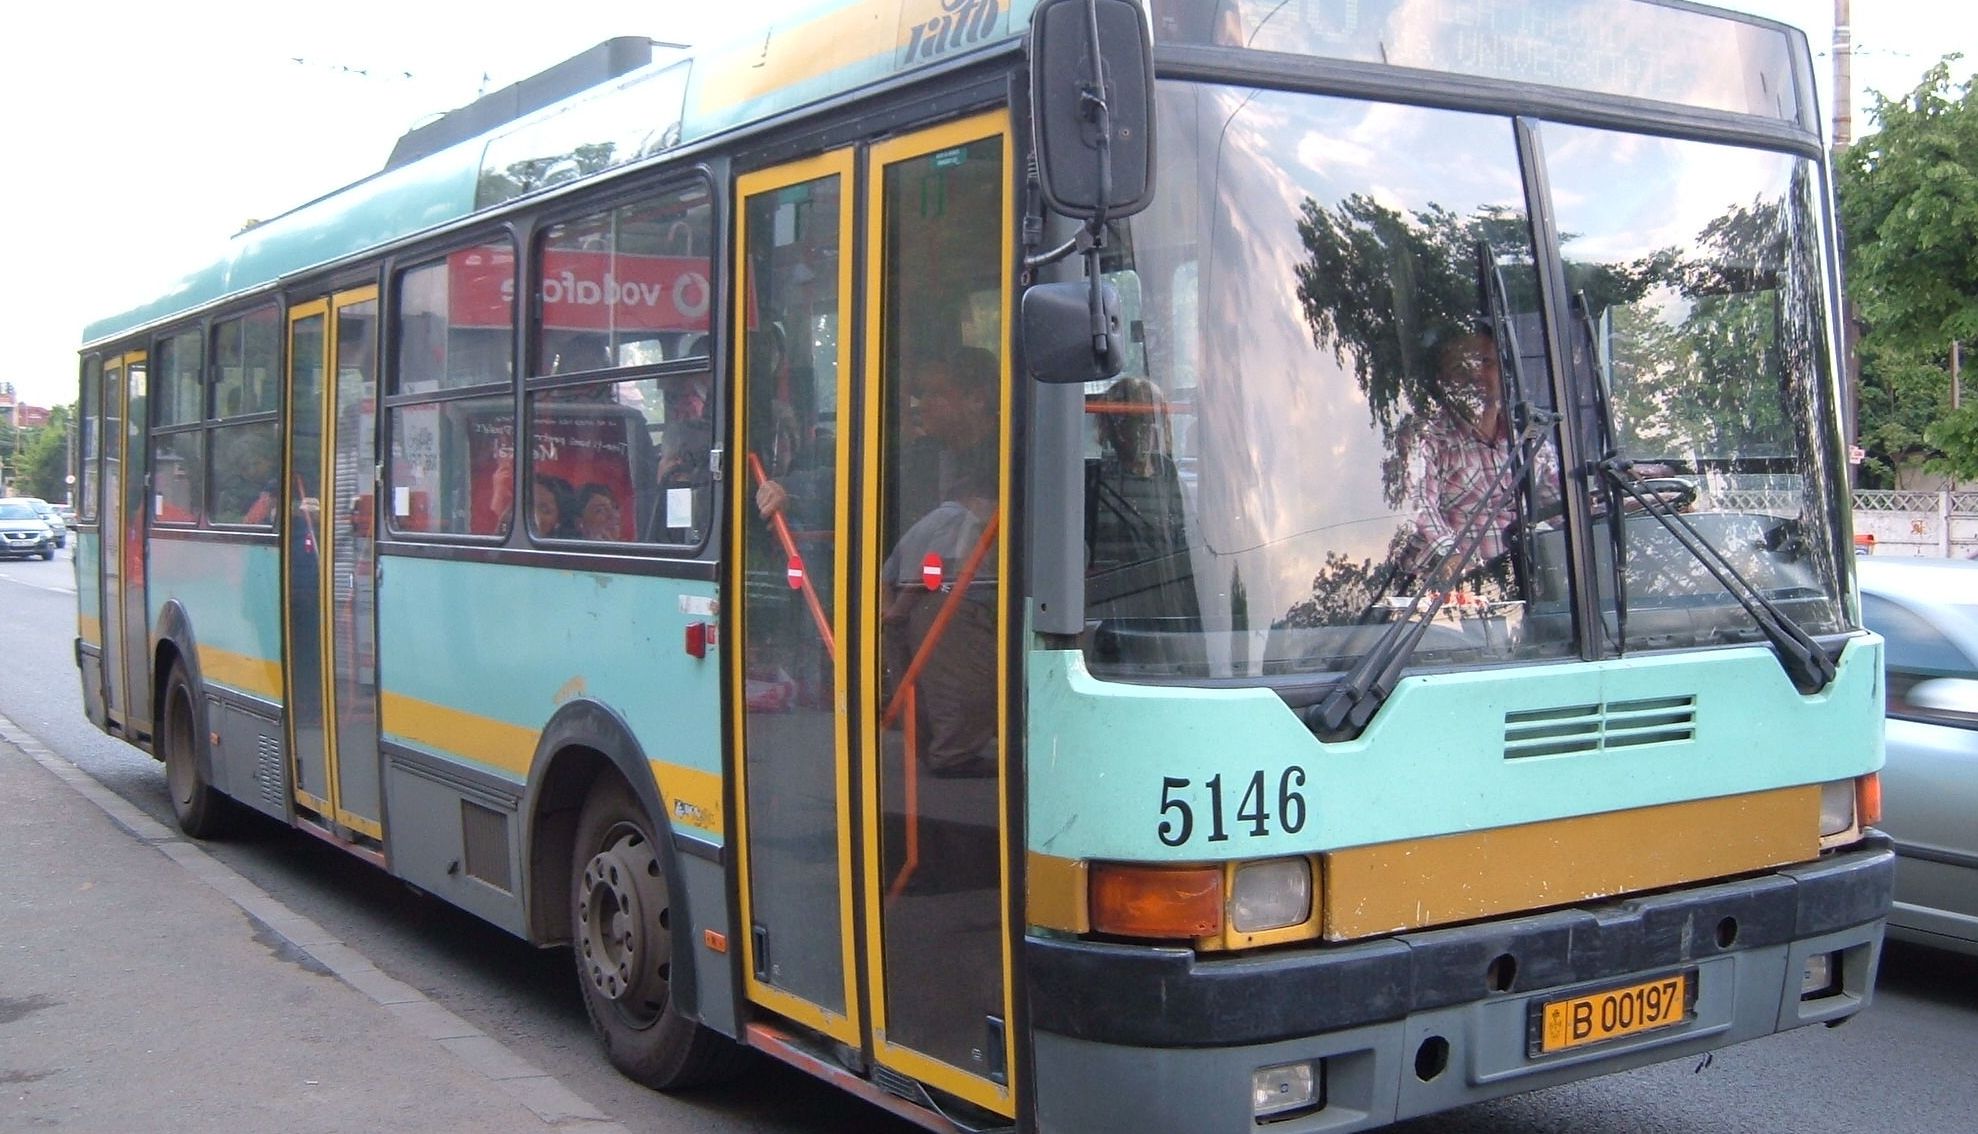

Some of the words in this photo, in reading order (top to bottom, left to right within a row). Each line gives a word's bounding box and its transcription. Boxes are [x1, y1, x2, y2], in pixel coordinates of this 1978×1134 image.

[1158, 765, 1306, 847] 5146
[1573, 1001, 1593, 1040] B
[1602, 982, 1677, 1032] 00197
